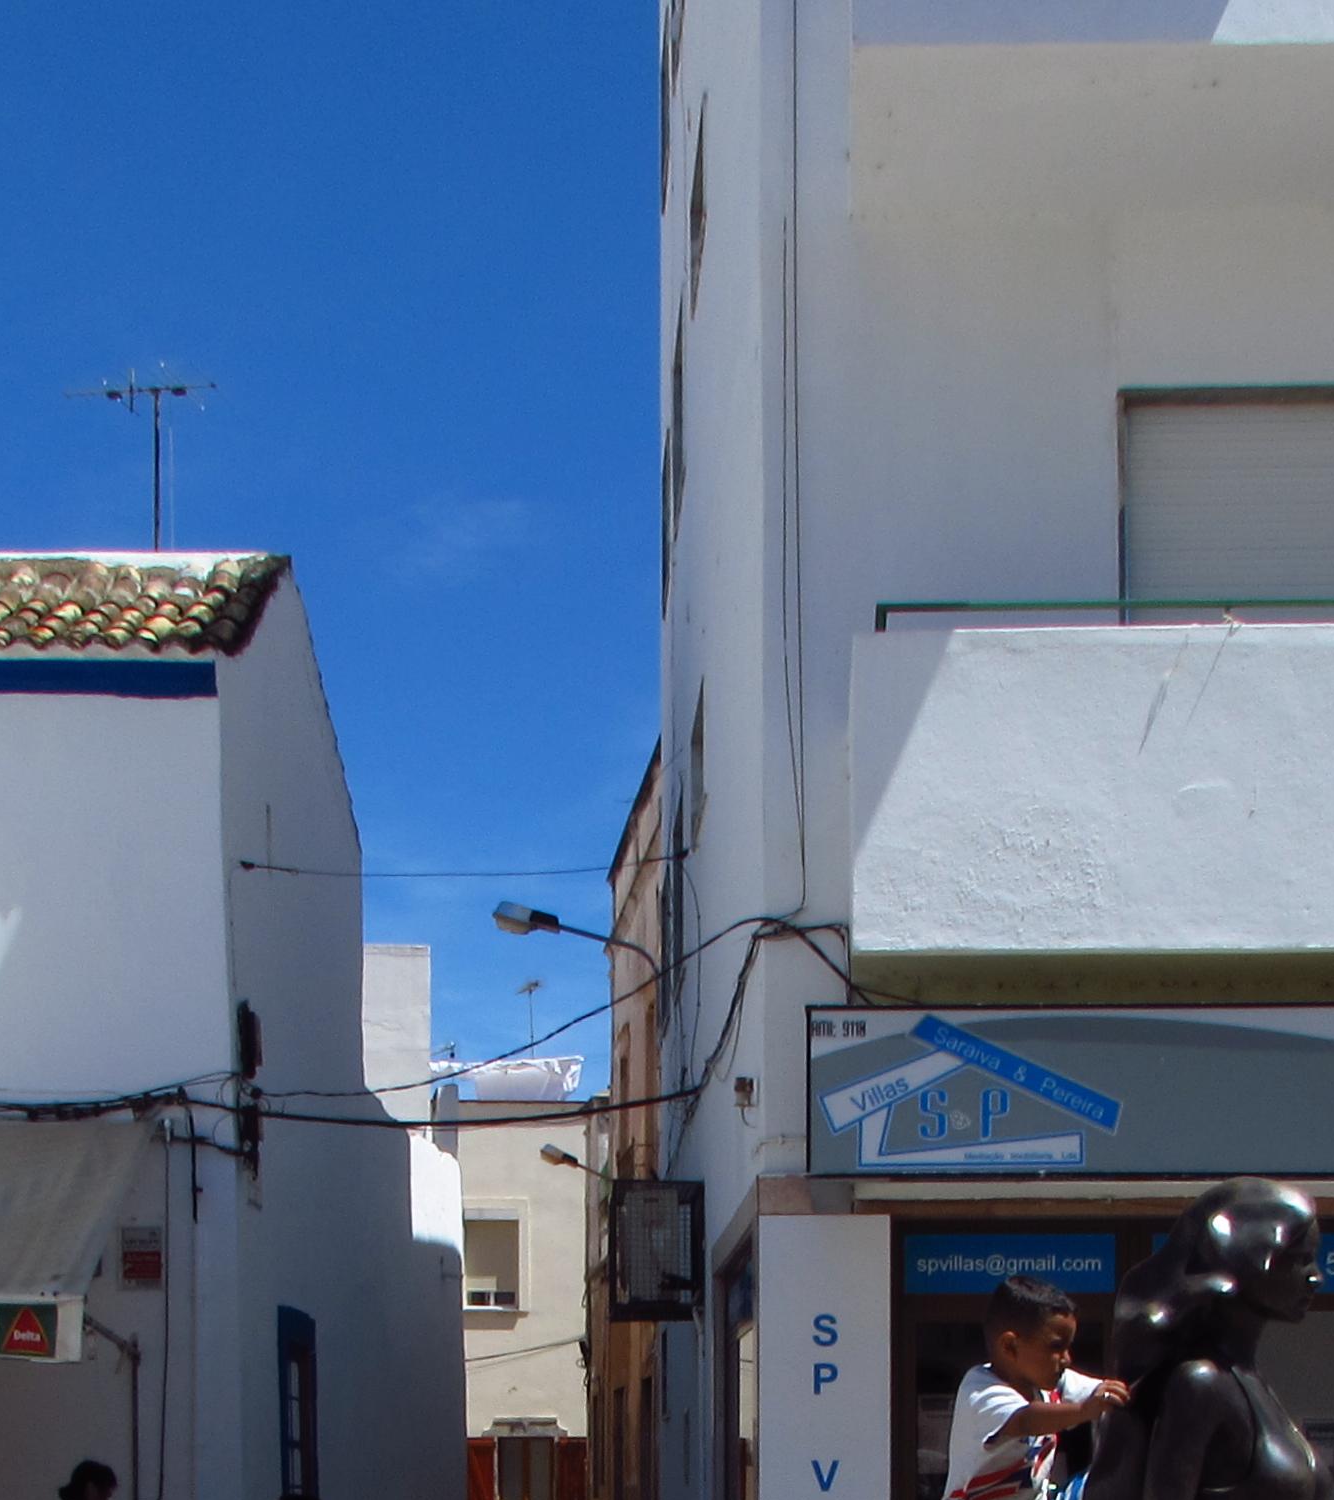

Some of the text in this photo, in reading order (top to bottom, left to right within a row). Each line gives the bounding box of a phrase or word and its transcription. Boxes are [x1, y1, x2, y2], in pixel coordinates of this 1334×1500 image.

[932, 1026, 1105, 1121] Saraiva & Pereira
[848, 1075, 911, 1114] Villas
[916, 1254, 1103, 1277] spvillas@gmail.com
